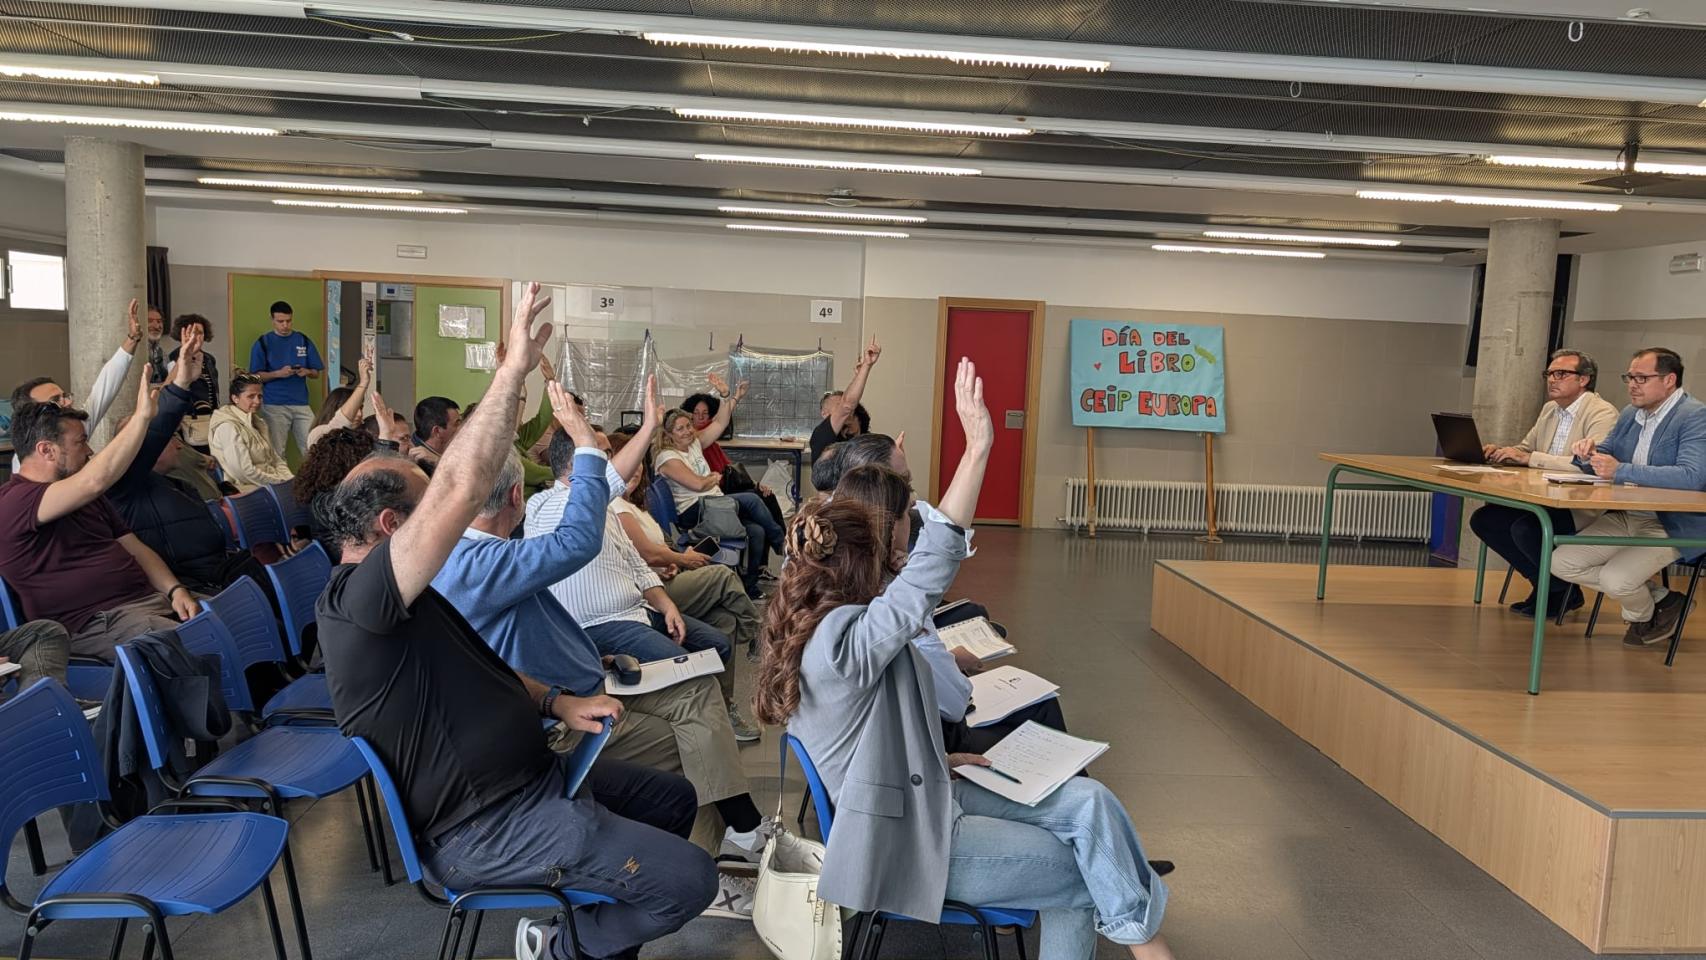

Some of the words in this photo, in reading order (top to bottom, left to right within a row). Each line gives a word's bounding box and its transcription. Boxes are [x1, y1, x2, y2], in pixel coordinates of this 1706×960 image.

[600, 297, 614, 308] 3º
[819, 307, 833, 318] 4º
[1102, 325, 1142, 346] DÍA
[1153, 331, 1190, 345] DEL
[1138, 391, 1217, 417] EUROPA
